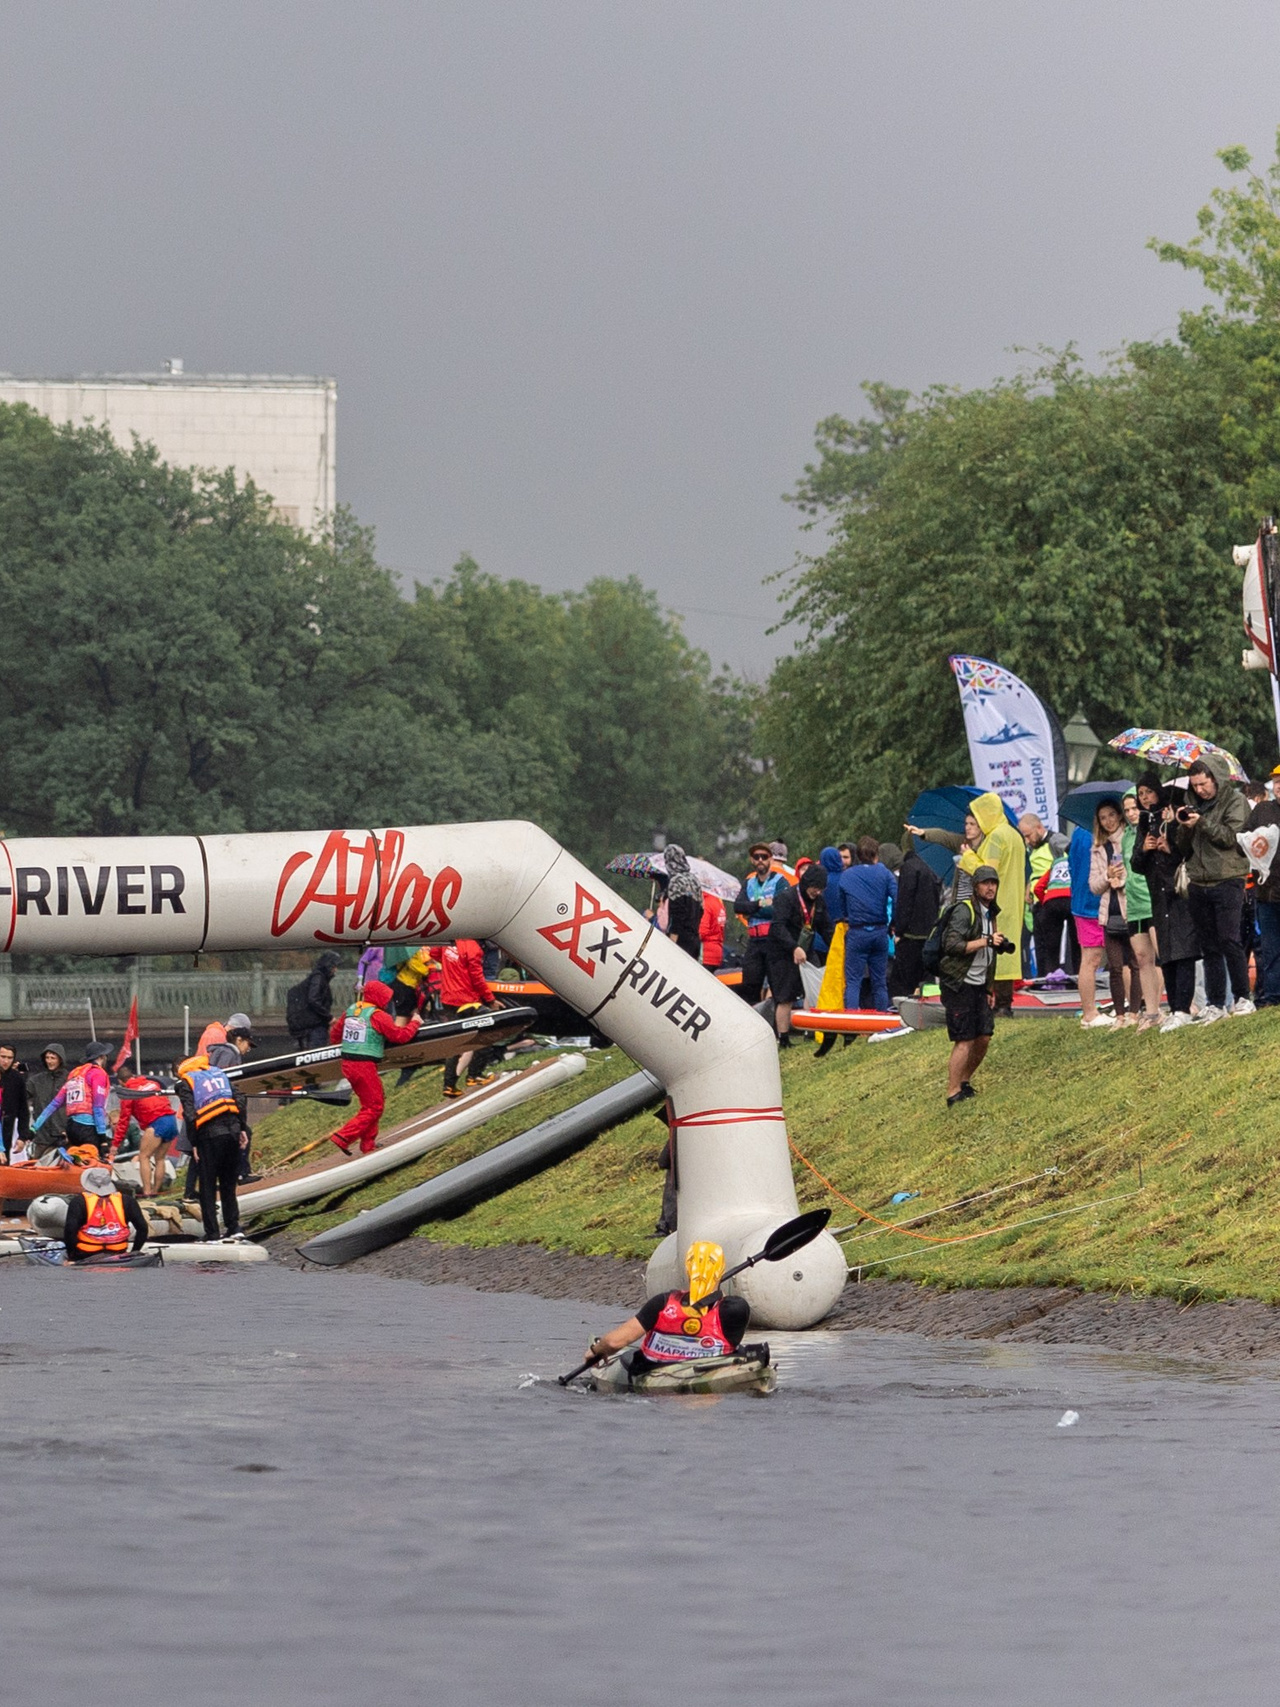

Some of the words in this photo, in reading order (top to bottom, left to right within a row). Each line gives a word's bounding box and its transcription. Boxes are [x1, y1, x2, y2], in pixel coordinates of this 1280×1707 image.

[271, 829, 463, 944] Atlas
[585, 925, 712, 1043] X-RIVER
[202, 1077, 226, 1093] 117
